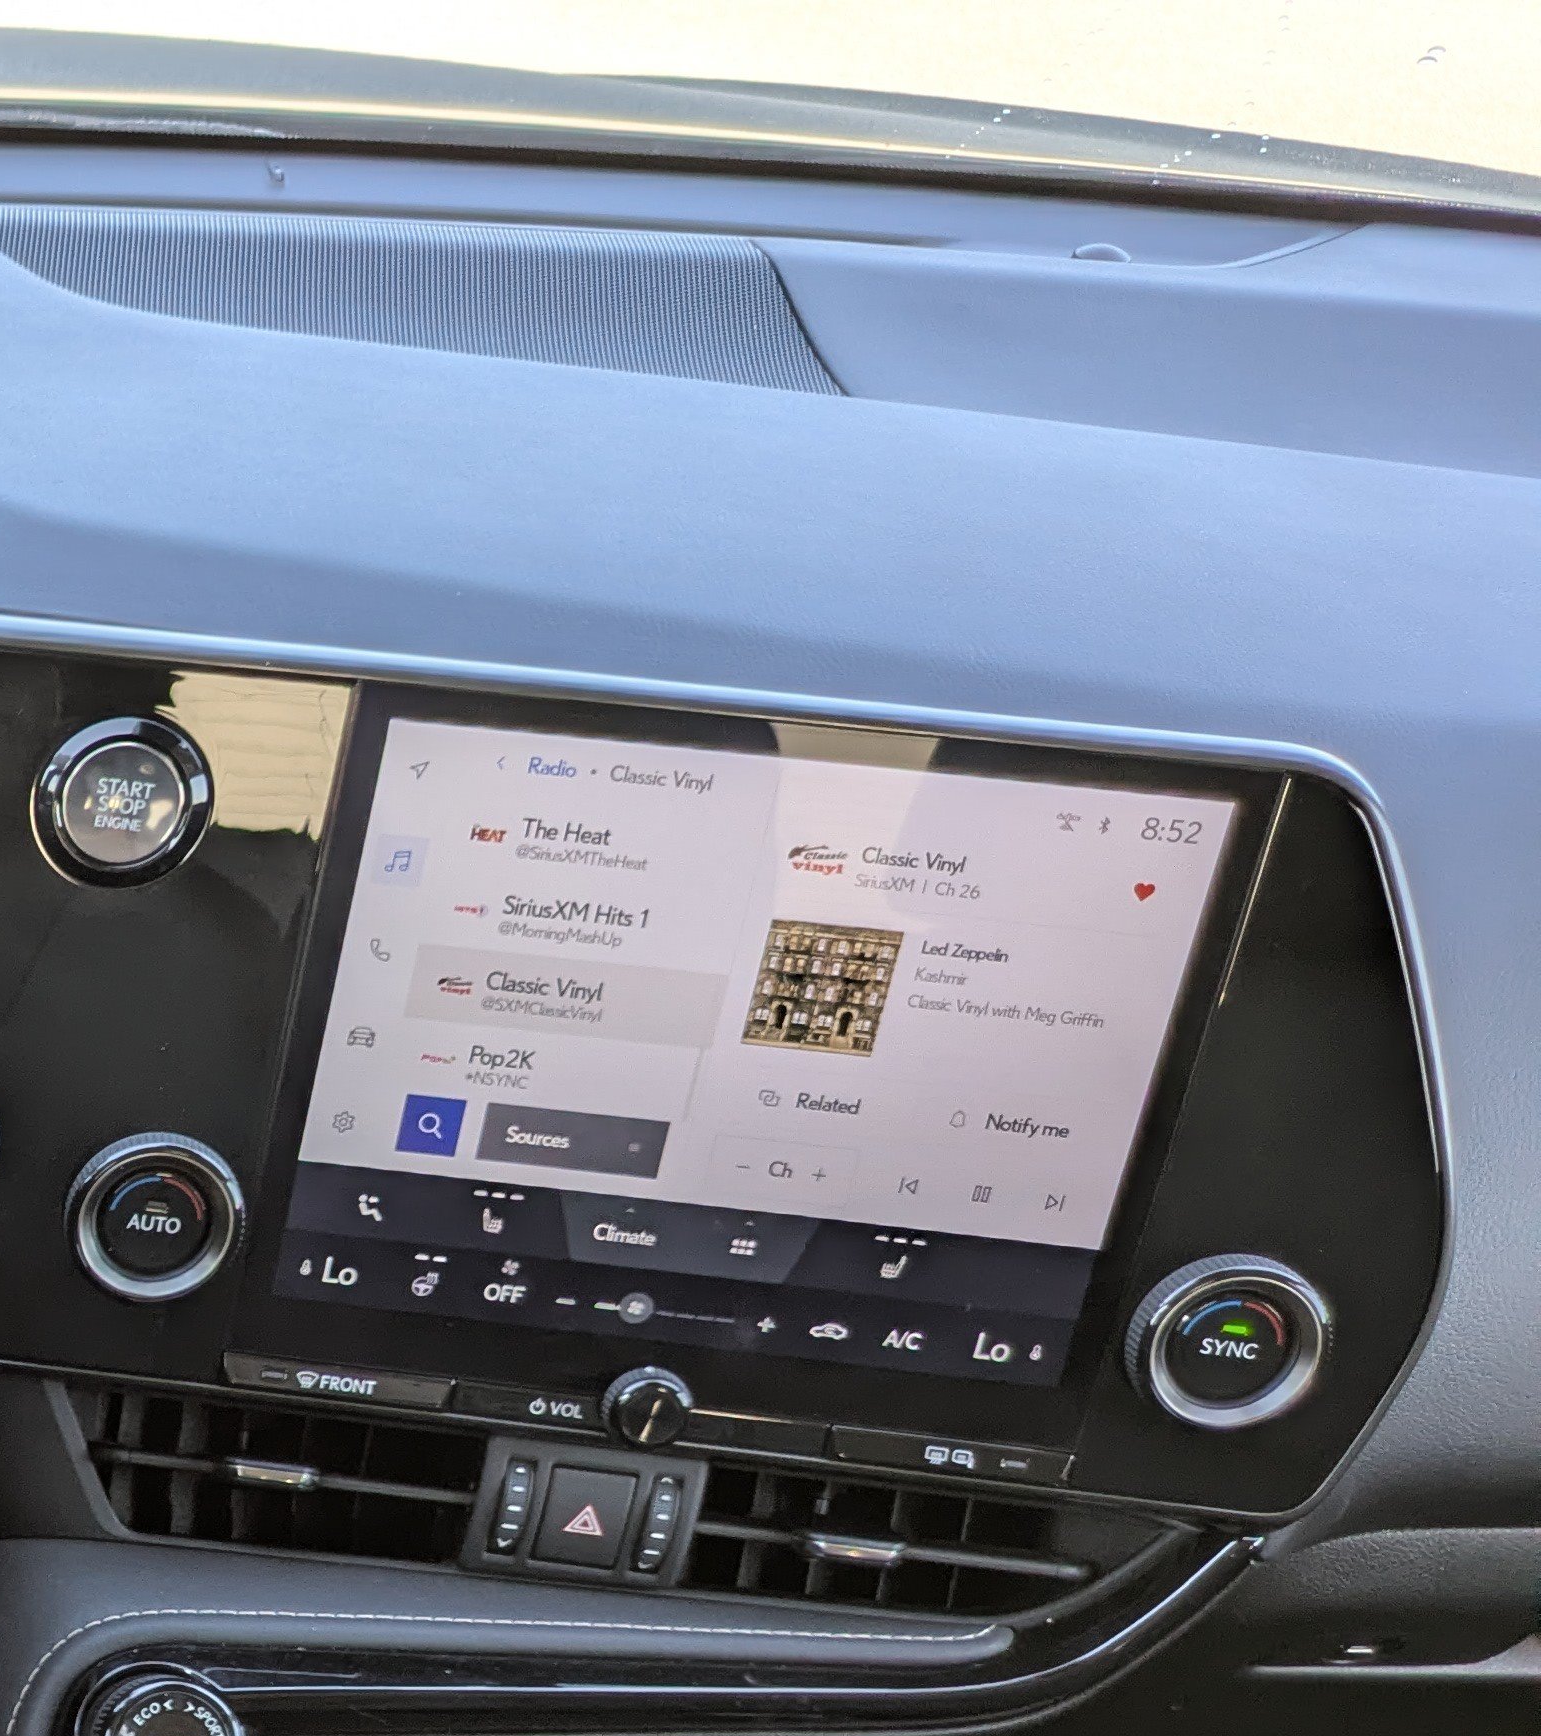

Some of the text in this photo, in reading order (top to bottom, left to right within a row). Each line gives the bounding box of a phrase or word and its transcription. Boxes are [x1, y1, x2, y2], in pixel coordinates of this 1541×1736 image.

[95, 777, 157, 800] START
[527, 756, 715, 796] Radio Classic Vinyl
[96, 795, 147, 816] STOP
[93, 815, 143, 832] ENGINE
[522, 817, 612, 848] The Heat
[1140, 815, 1203, 845] 8:52
[862, 845, 967, 877] Classic Vinyl
[854, 872, 916, 894] SiriusXM
[935, 880, 956, 897] Ch
[959, 882, 982, 900] 26
[502, 894, 590, 924] SiriusXM
[595, 900, 634, 928] Hits
[639, 908, 650, 929] 1
[497, 919, 623, 949] @MorningMashUp
[921, 939, 1010, 965] Led Zeppelin
[486, 970, 549, 997] Classic
[556, 976, 604, 1002] Vinyl
[914, 966, 968, 987] Kashmir
[906, 993, 1105, 1029] Classic Vinyl with Meg Griffin
[468, 1044, 537, 1071] Pop2K
[796, 1091, 861, 1115] Related
[504, 1125, 571, 1150] Sources
[984, 1113, 1070, 1140] Notify me
[768, 1160, 793, 1180] Ch
[126, 1214, 182, 1235] AUTO
[593, 1221, 657, 1247] Climate
[321, 1255, 359, 1286] Lo
[483, 1282, 527, 1304] OFF
[881, 1328, 925, 1352] A/C
[972, 1331, 1012, 1363] Lo
[1199, 1337, 1259, 1360] SYNC
[319, 1374, 377, 1397] FRONT
[549, 1400, 584, 1420] VOL
[133, 1701, 161, 1727] ECO
